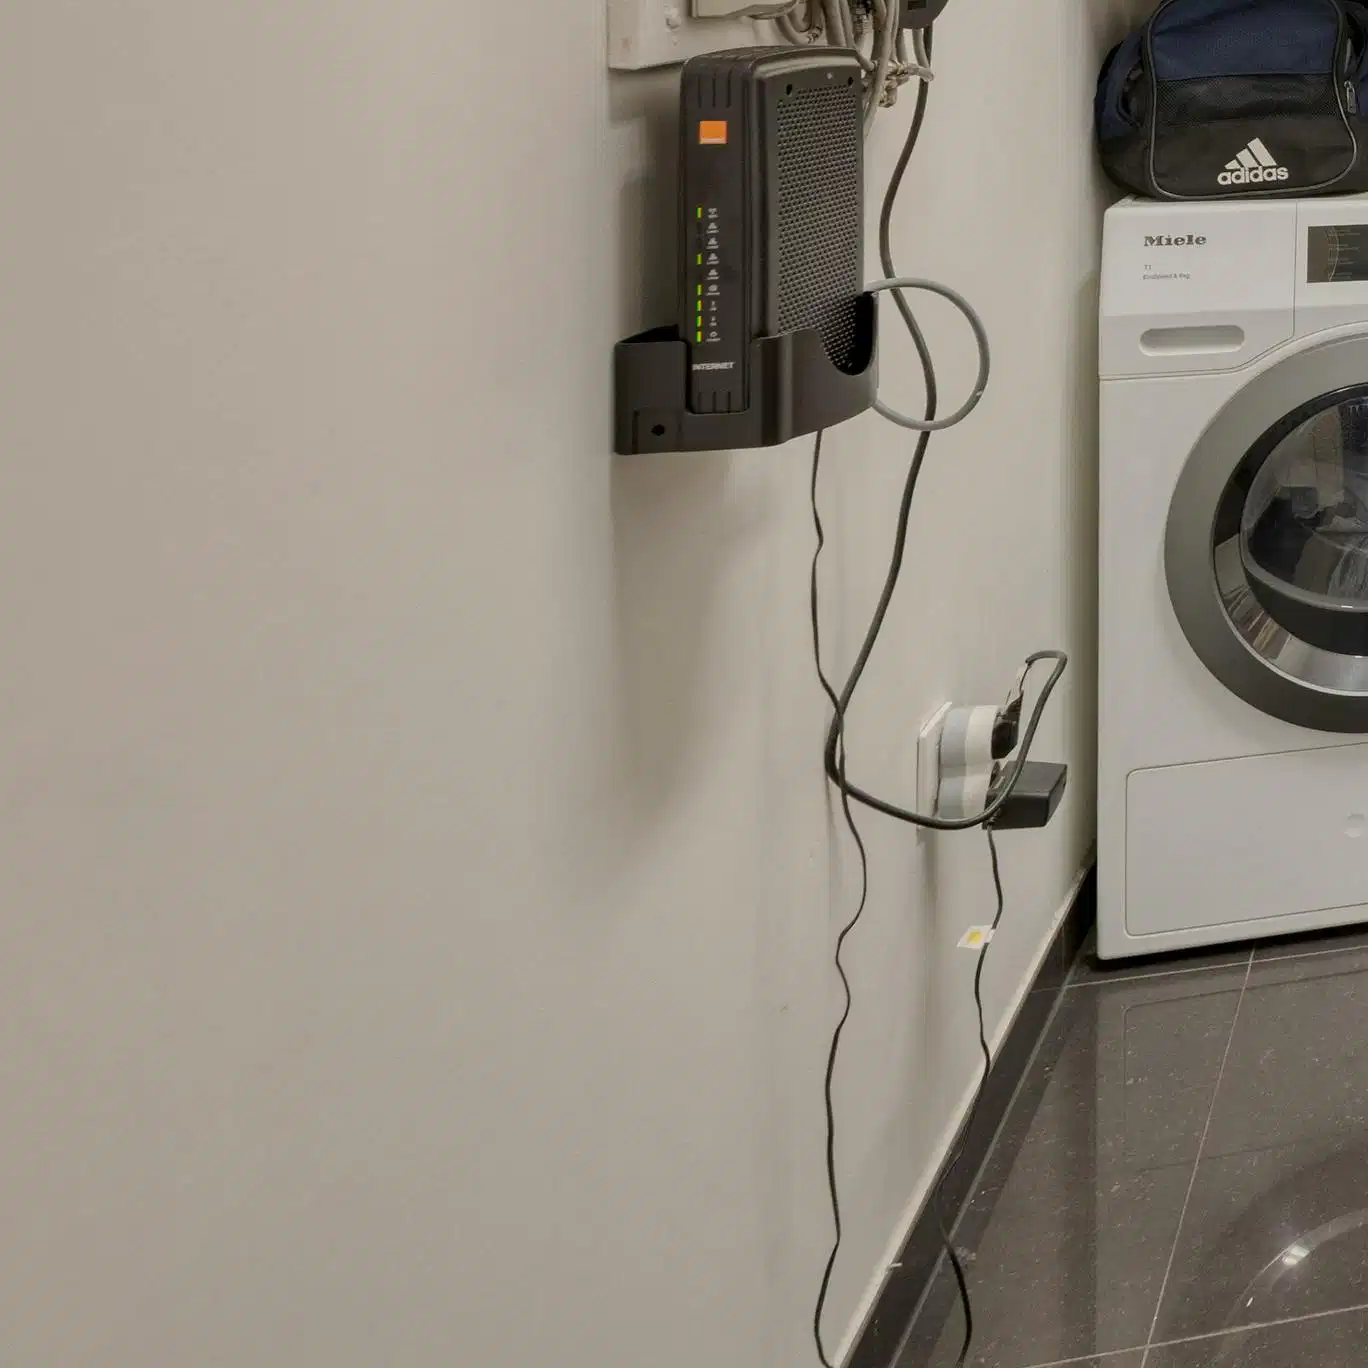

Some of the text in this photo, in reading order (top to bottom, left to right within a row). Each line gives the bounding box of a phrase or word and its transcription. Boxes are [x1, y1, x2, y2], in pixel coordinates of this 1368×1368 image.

[1217, 167, 1289, 186] adidas
[1144, 235, 1207, 247] Miele
[692, 362, 735, 371] INTERNET
